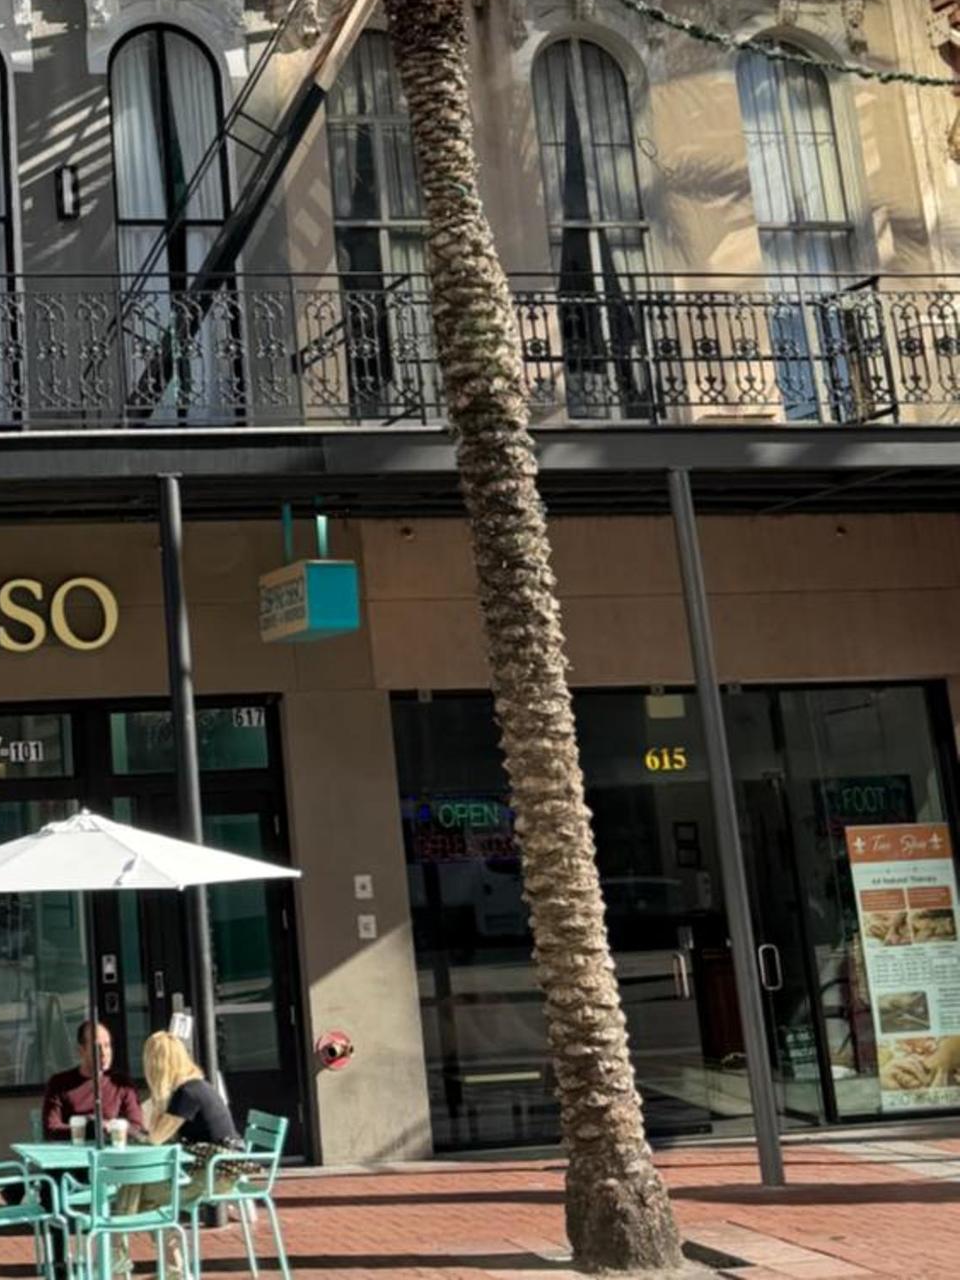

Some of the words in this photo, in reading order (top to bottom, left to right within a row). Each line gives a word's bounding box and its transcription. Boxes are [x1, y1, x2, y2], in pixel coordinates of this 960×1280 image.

[234, 707, 266, 728] 617
[645, 747, 688, 771] 615
[841, 786, 886, 813] FOOT
[438, 803, 500, 828] OPEN
